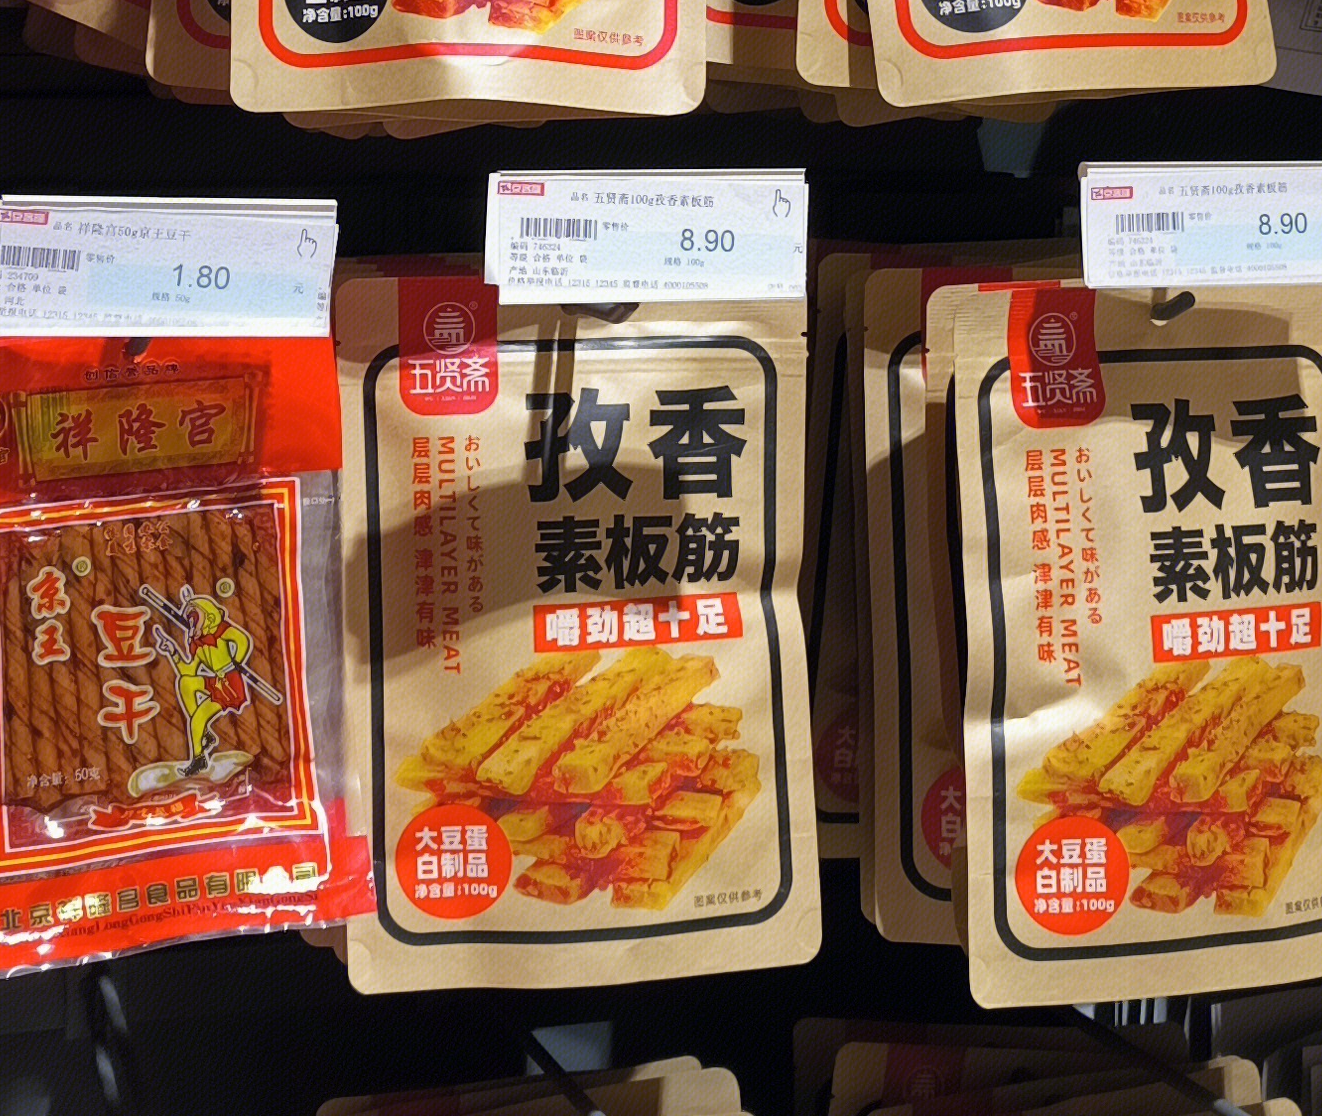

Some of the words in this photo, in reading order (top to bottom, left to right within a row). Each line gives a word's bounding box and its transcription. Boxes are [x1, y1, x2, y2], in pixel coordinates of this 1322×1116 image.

[679, 228, 735, 253] 8.90
[1258, 212, 1308, 235] 8.90
[172, 264, 231, 290] 1.80
[408, 358, 490, 394] 五贤斋
[1019, 368, 1097, 407] 五贤斋
[50, 400, 227, 462] 祥隆宫
[525, 385, 747, 504] 孜香
[1131, 394, 1320, 514] 孜香
[412, 437, 433, 536] 层层肉感
[438, 436, 458, 595] MULTILAYER
[1024, 450, 1051, 550] 层层肉感
[534, 512, 740, 593] 素板筋
[1050, 449, 1075, 607] MULTILAYER
[1149, 520, 1318, 604] 素板筋
[414, 549, 436, 649] 津津有味
[545, 598, 728, 648] 嚼劲超十足
[1033, 563, 1056, 663] 津津有味
[1162, 608, 1312, 656] 嚼劲超十足
[442, 607, 460, 674] MEAT
[1060, 619, 1082, 687] MEAT
[92, 605, 159, 744] 豆干
[415, 826, 488, 852] 大豆蛋
[416, 852, 489, 880] 白制品
[1035, 837, 1107, 865] 大豆蛋
[1036, 865, 1107, 894] 白制品
